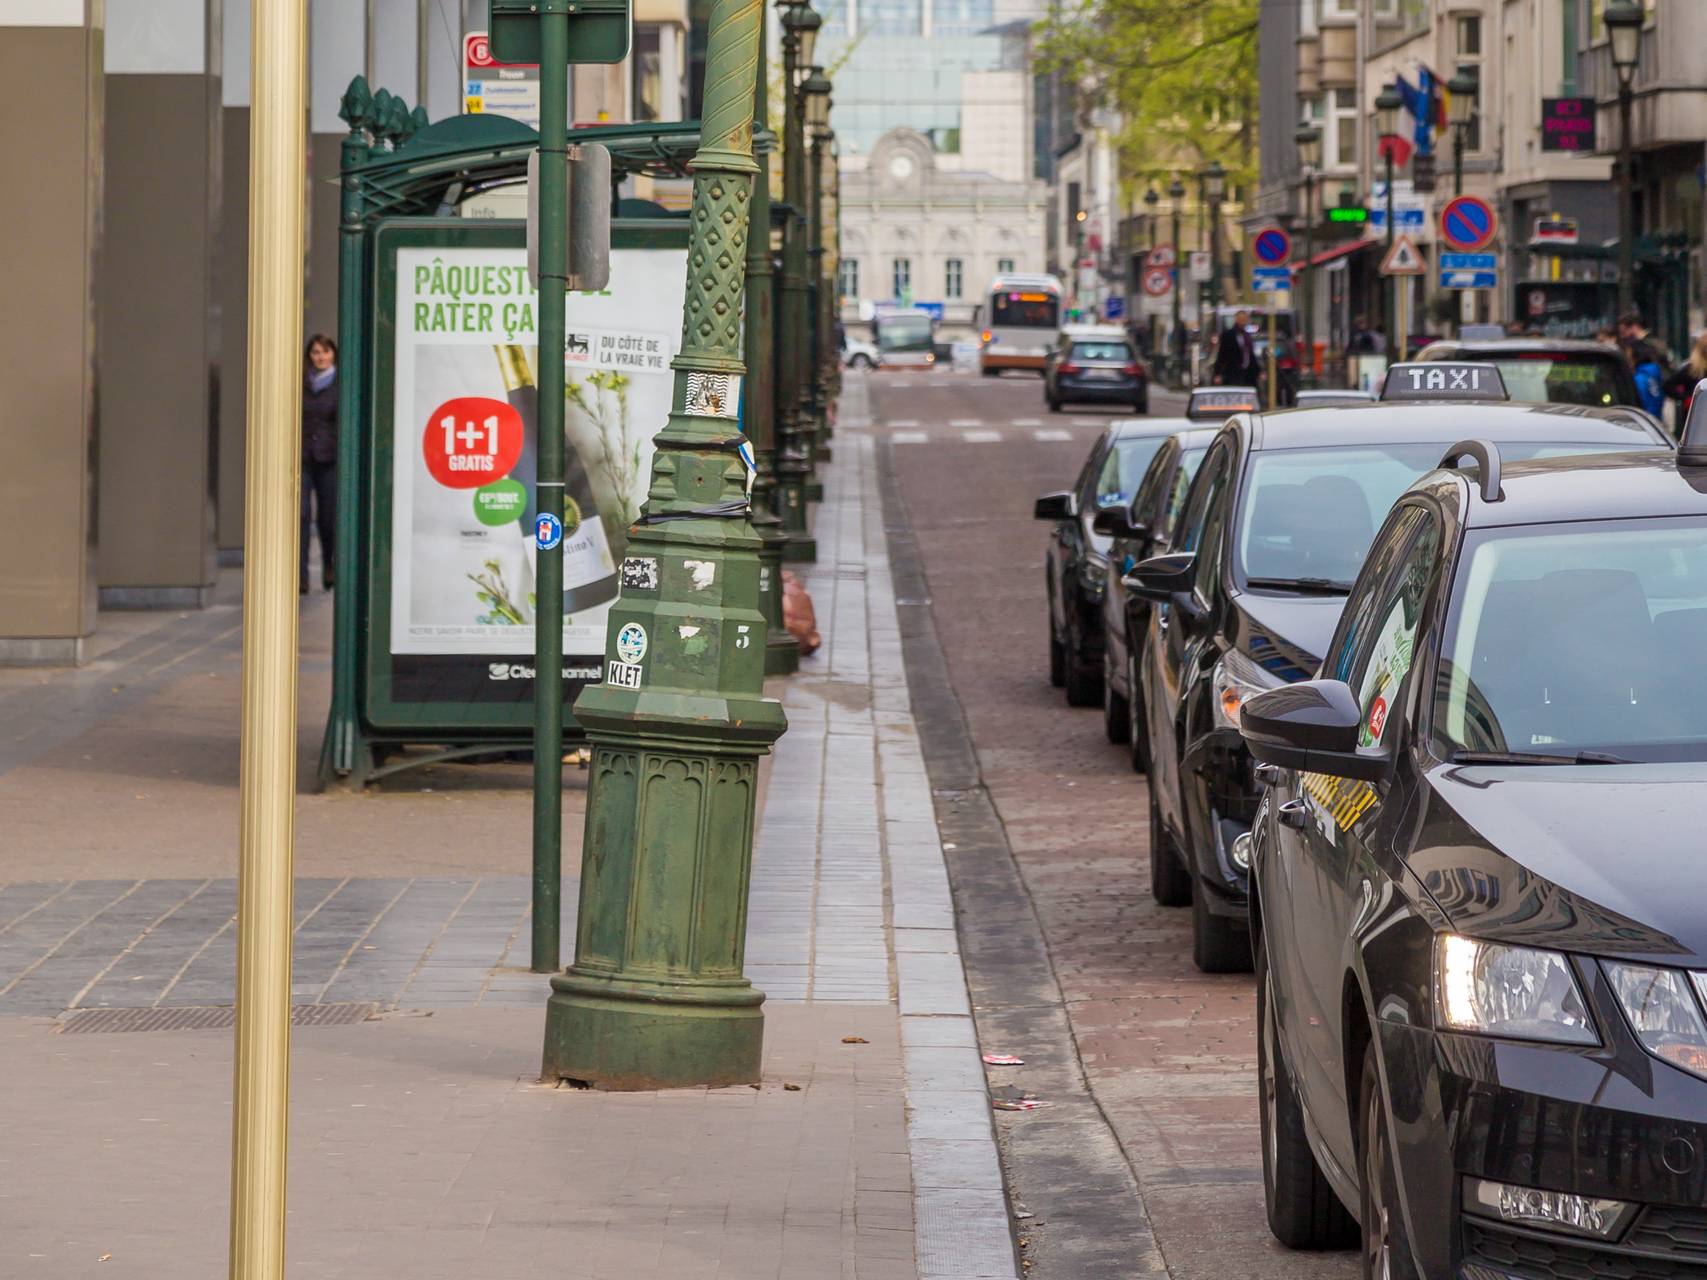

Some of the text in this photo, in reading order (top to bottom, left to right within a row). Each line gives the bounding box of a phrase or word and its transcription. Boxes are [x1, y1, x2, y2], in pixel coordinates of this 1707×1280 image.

[414, 257, 537, 299] PÂQUEST
[414, 303, 535, 341] RATER ÇA
[601, 335, 659, 353] DU CÔTÉ DE
[600, 351, 612, 364] LA
[616, 353, 645, 367] VRAIE
[647, 356, 664, 369] VIE
[1408, 368, 1479, 389] TAXI
[441, 415, 498, 455] 1+1
[449, 455, 494, 471] GRATIS
[609, 663, 641, 687] KLET
